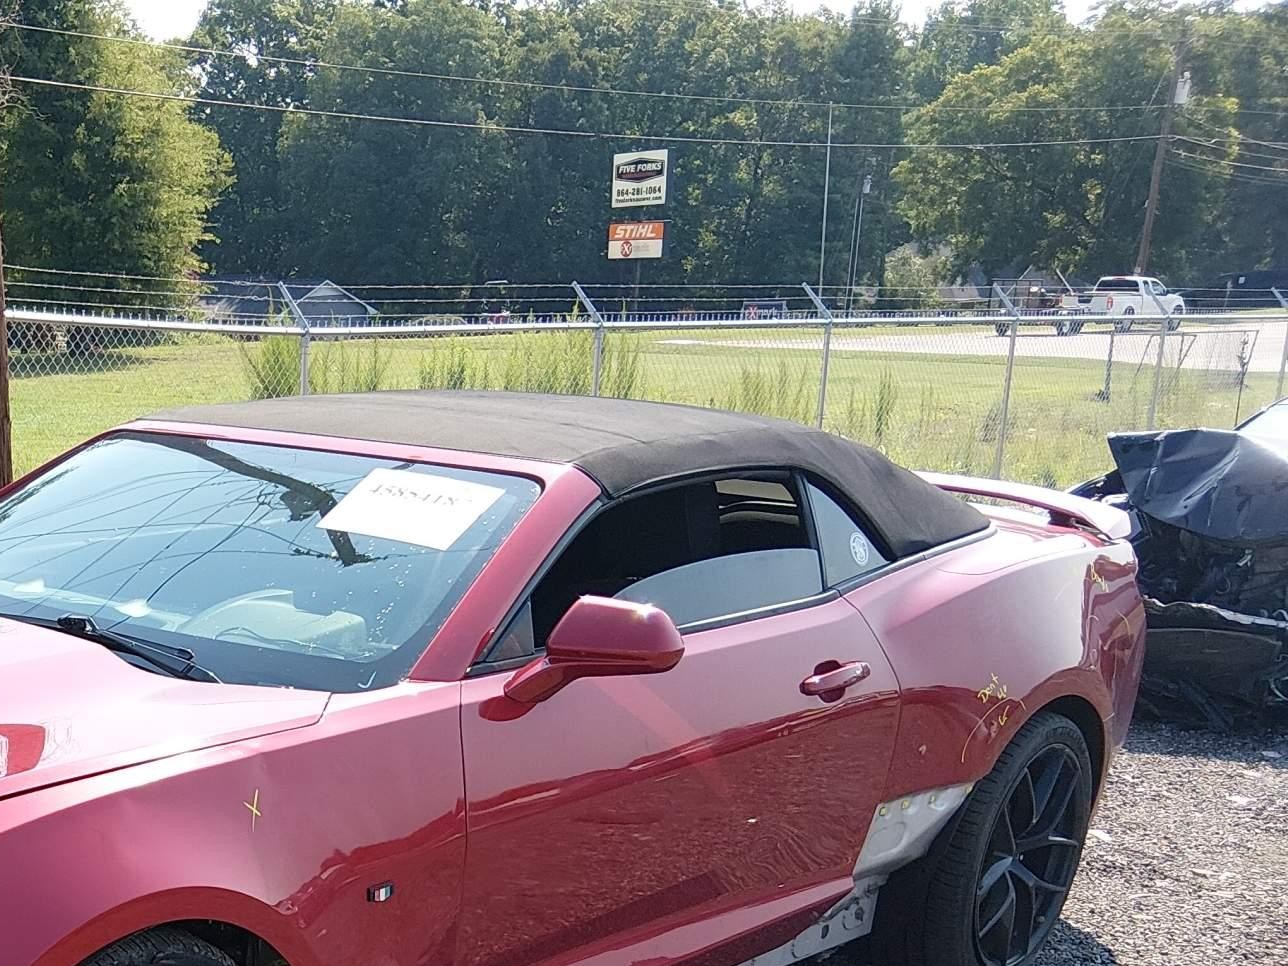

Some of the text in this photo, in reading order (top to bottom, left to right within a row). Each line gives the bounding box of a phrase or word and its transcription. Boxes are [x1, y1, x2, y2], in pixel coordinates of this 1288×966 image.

[619, 164, 636, 175] FIVE
[637, 162, 662, 173] FORKS
[616, 185, 662, 197] 864-281-1064
[614, 224, 657, 239] STIHL
